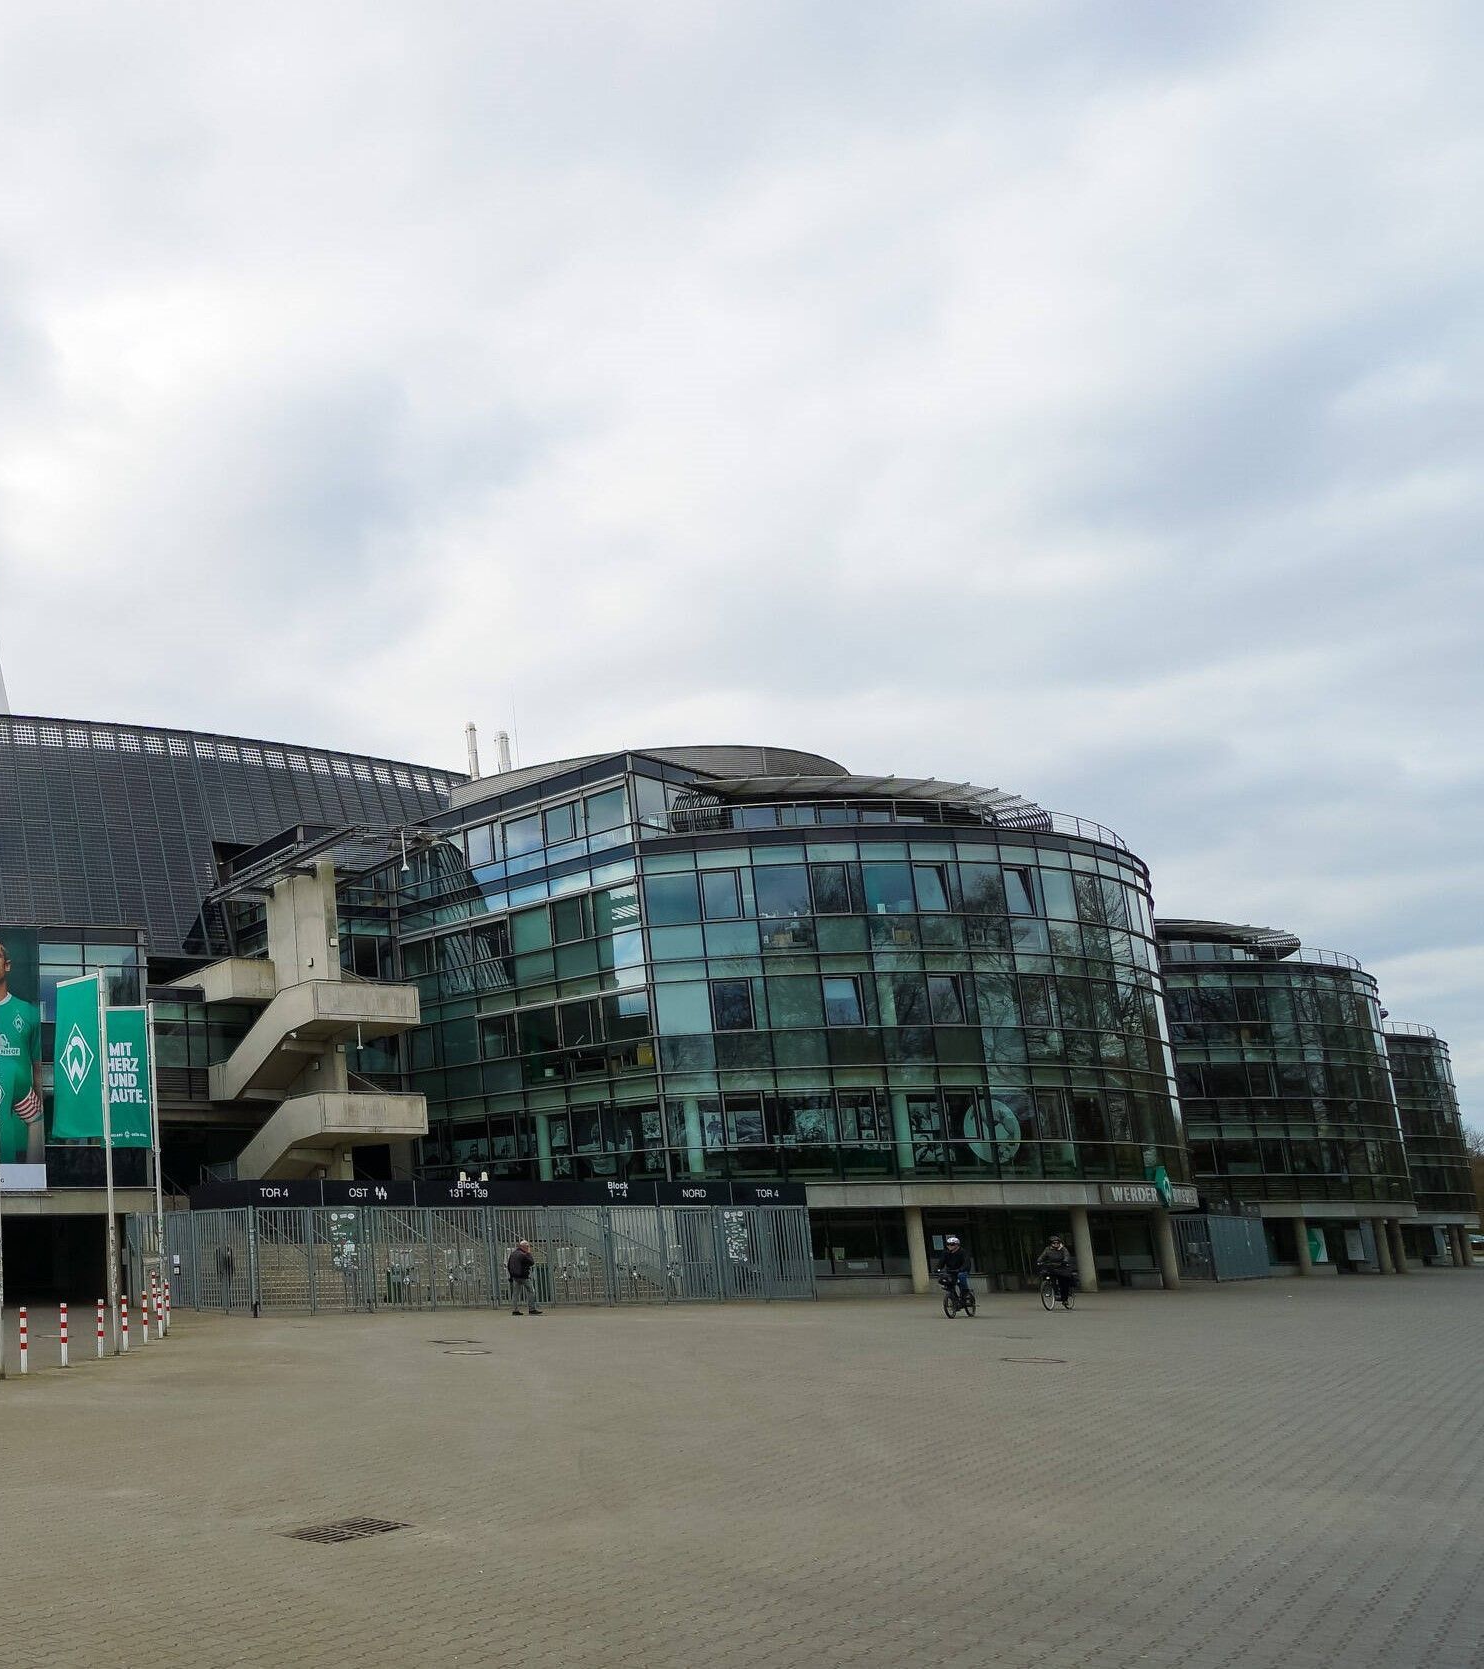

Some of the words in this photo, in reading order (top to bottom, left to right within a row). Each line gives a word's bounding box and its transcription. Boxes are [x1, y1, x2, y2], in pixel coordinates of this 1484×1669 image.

[109, 1042, 132, 1056] MIT
[107, 1058, 139, 1072] HERZ
[108, 1073, 138, 1088] UND
[109, 1088, 147, 1104] AUTE.
[457, 1181, 480, 1190] Block
[607, 1181, 629, 1190] Block
[260, 1188, 279, 1198] TOR
[282, 1188, 289, 1198] 4
[349, 1188, 368, 1198] OST
[449, 1189, 464, 1198] 131
[473, 1189, 488, 1198] 139
[621, 1189, 628, 1198] 4
[682, 1189, 706, 1198] NORD
[756, 1189, 772, 1198] TOR
[774, 1189, 780, 1198] 4
[1111, 1186, 1159, 1202] WERDER
